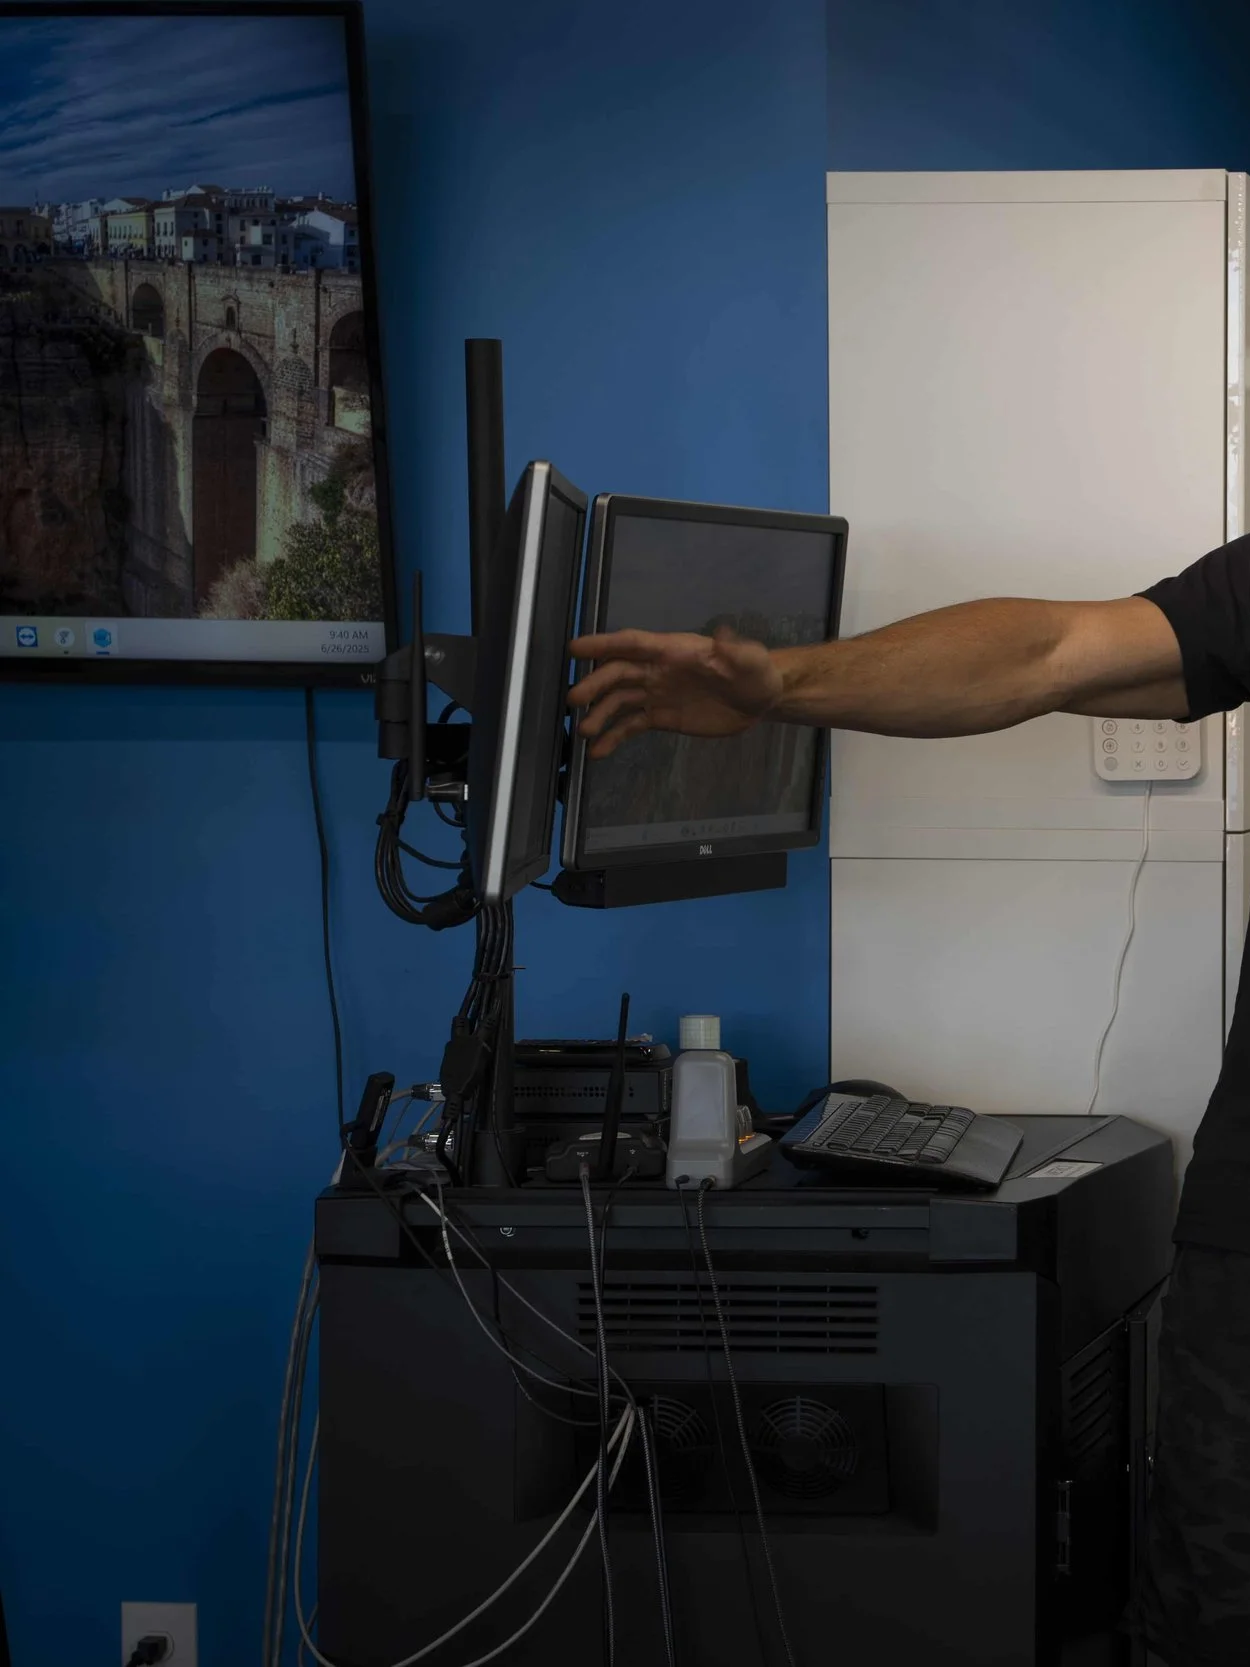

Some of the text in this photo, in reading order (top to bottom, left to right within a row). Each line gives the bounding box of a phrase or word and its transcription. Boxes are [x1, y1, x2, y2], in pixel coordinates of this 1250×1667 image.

[329, 630, 368, 640] 9:40 AM
[321, 643, 370, 655] 6/26/2025
